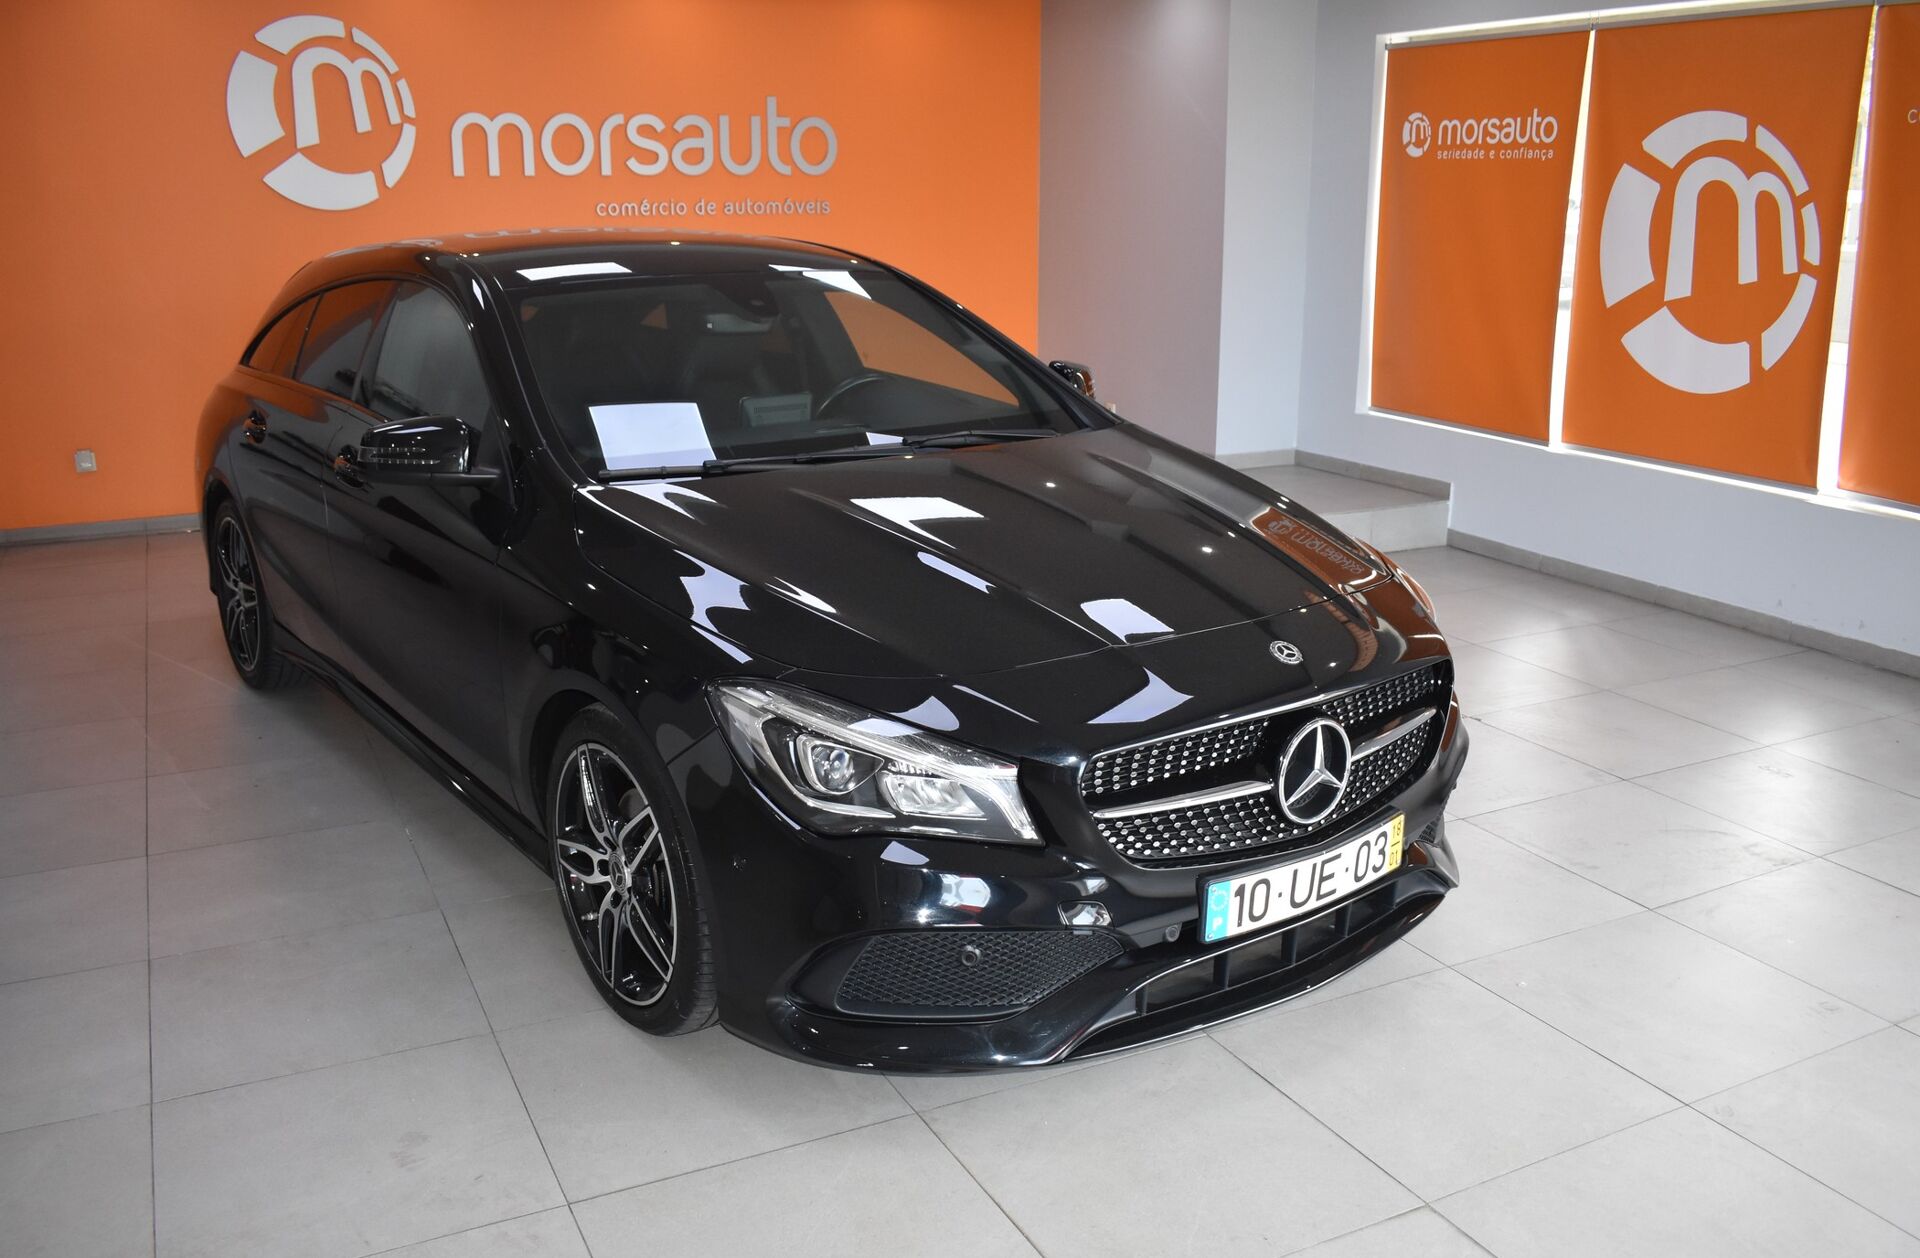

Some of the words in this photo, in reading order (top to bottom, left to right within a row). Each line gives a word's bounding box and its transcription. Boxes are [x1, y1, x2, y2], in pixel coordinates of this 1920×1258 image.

[1907, 109, 1920, 124] c
[1437, 108, 1558, 146] morsauto
[451, 96, 839, 177] morsauto
[1437, 149, 1485, 160] seriedade
[1489, 150, 1495, 159] e
[1500, 148, 1553, 161] confiança
[596, 199, 687, 217] comércio
[695, 199, 717, 216] de
[724, 198, 832, 216] automóveis
[1213, 917, 1223, 932] P
